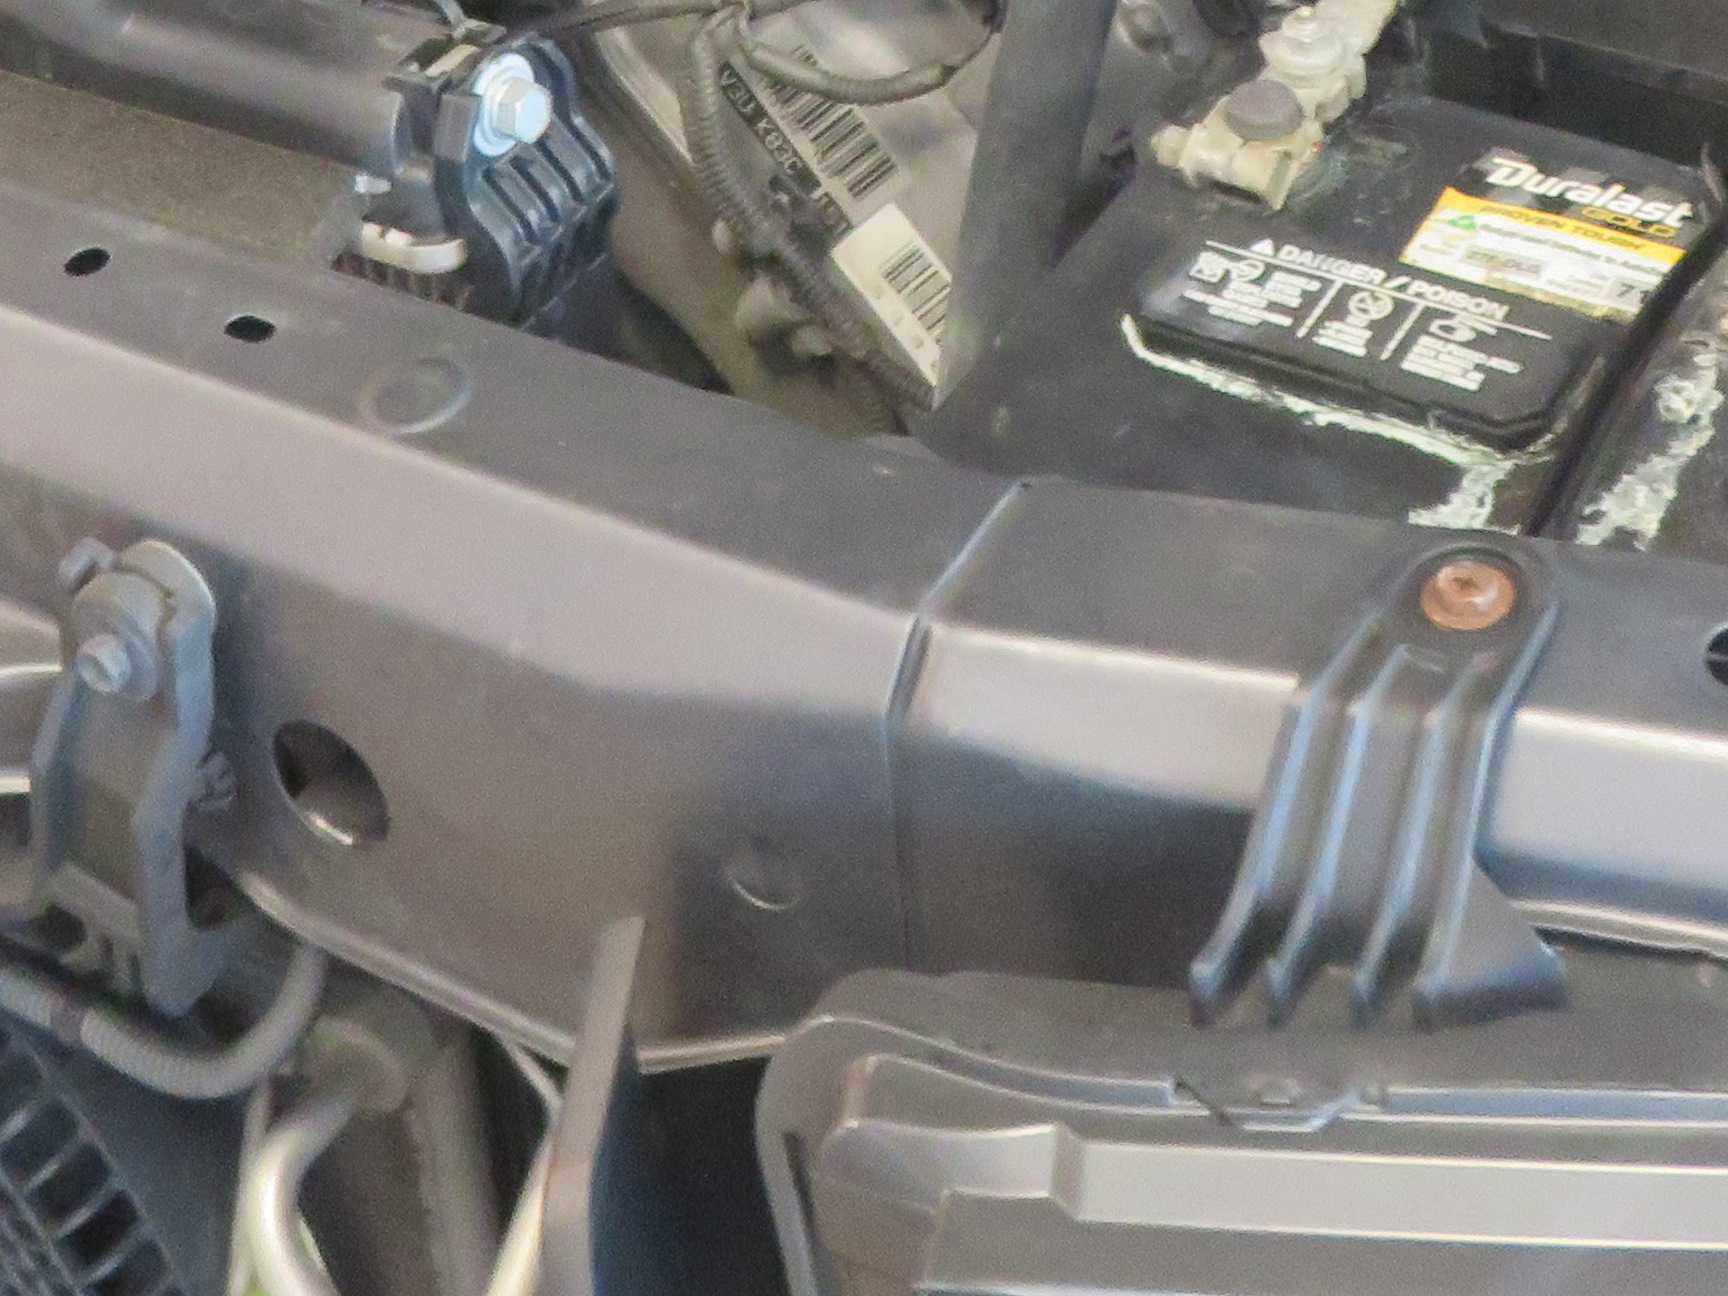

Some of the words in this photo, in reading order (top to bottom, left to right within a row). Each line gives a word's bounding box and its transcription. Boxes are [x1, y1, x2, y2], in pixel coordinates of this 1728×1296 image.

[1485, 157, 1694, 229] Duralast
[1581, 206, 1681, 239] GOLD
[1275, 243, 1388, 287] DANGER
[1407, 278, 1511, 319] POISON
